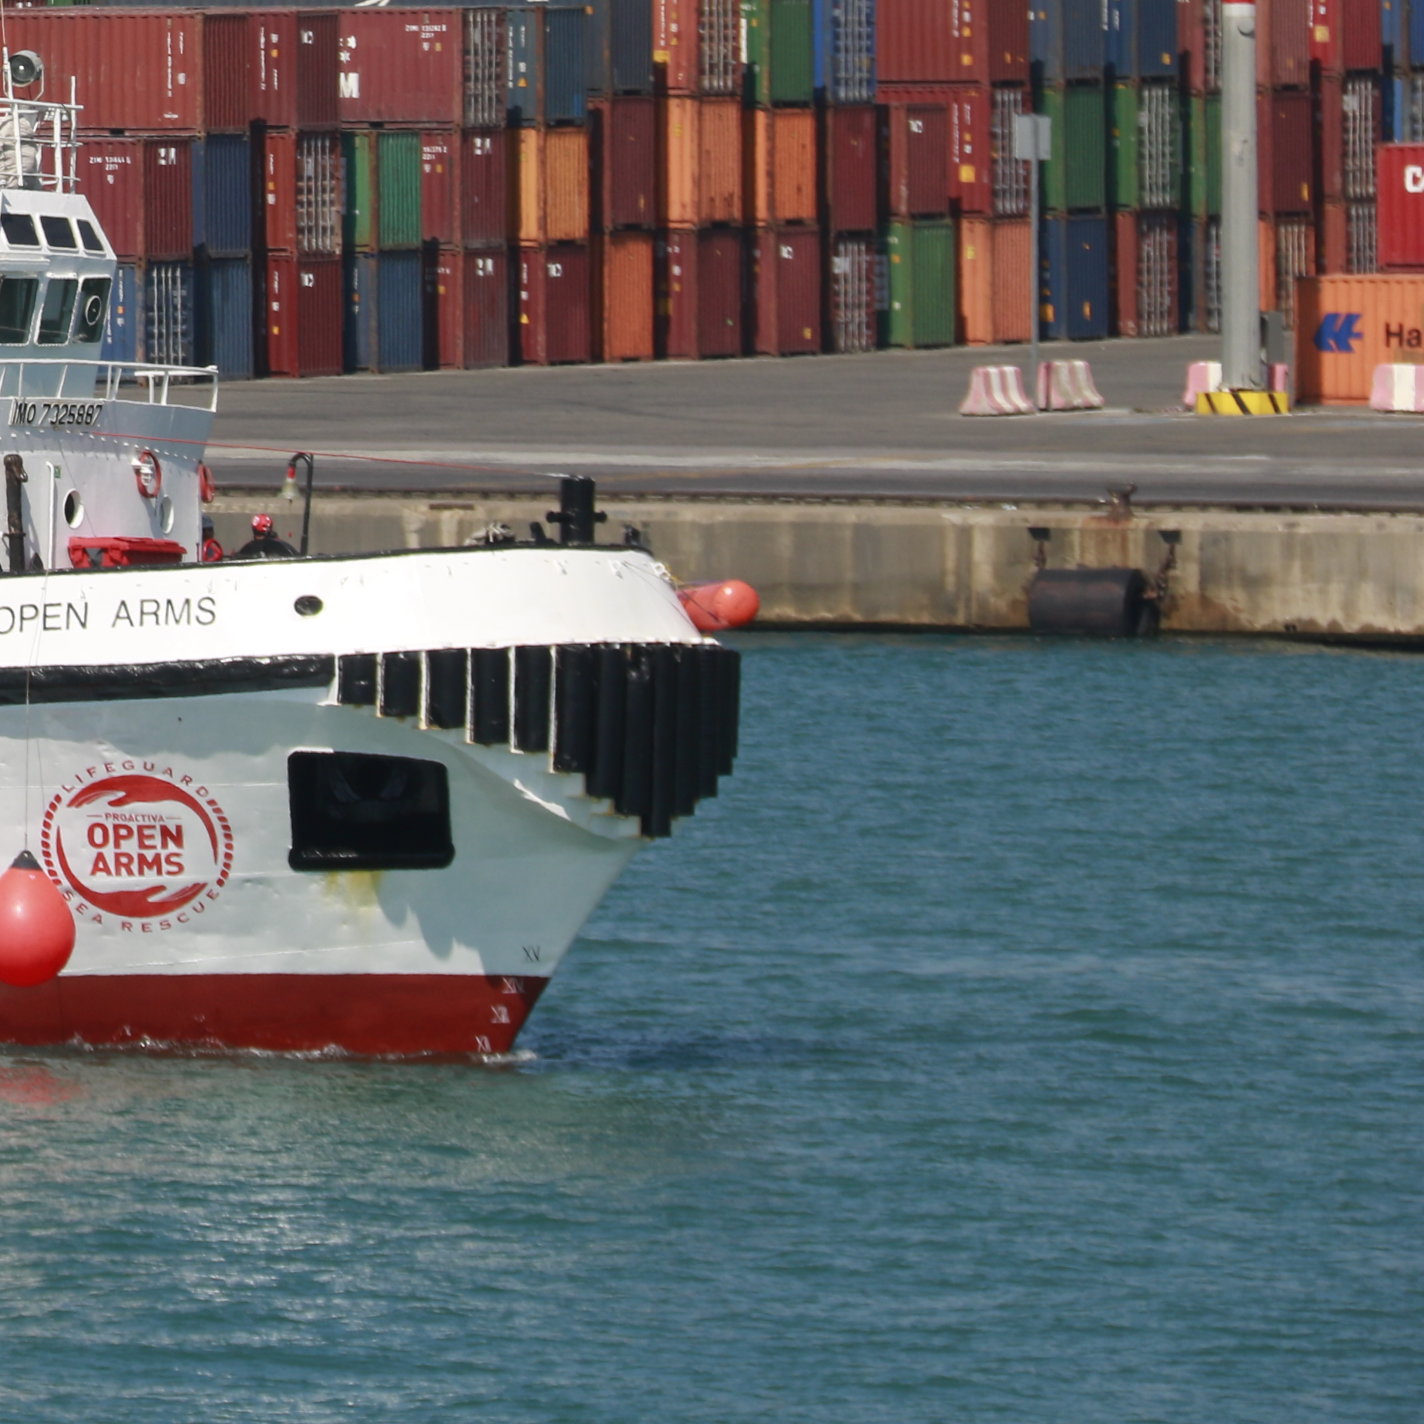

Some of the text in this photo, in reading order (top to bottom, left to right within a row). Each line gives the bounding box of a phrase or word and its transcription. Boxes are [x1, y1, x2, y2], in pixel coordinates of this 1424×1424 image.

[11, 402, 103, 426] IMO 7325887
[111, 596, 217, 629] ARMS
[61, 759, 210, 799] LIFEGUARD
[103, 812, 166, 823] PROACTIVA
[87, 822, 185, 850] OPEN
[89, 851, 186, 877] ARMS
[61, 885, 220, 934] SEA RESCUE
